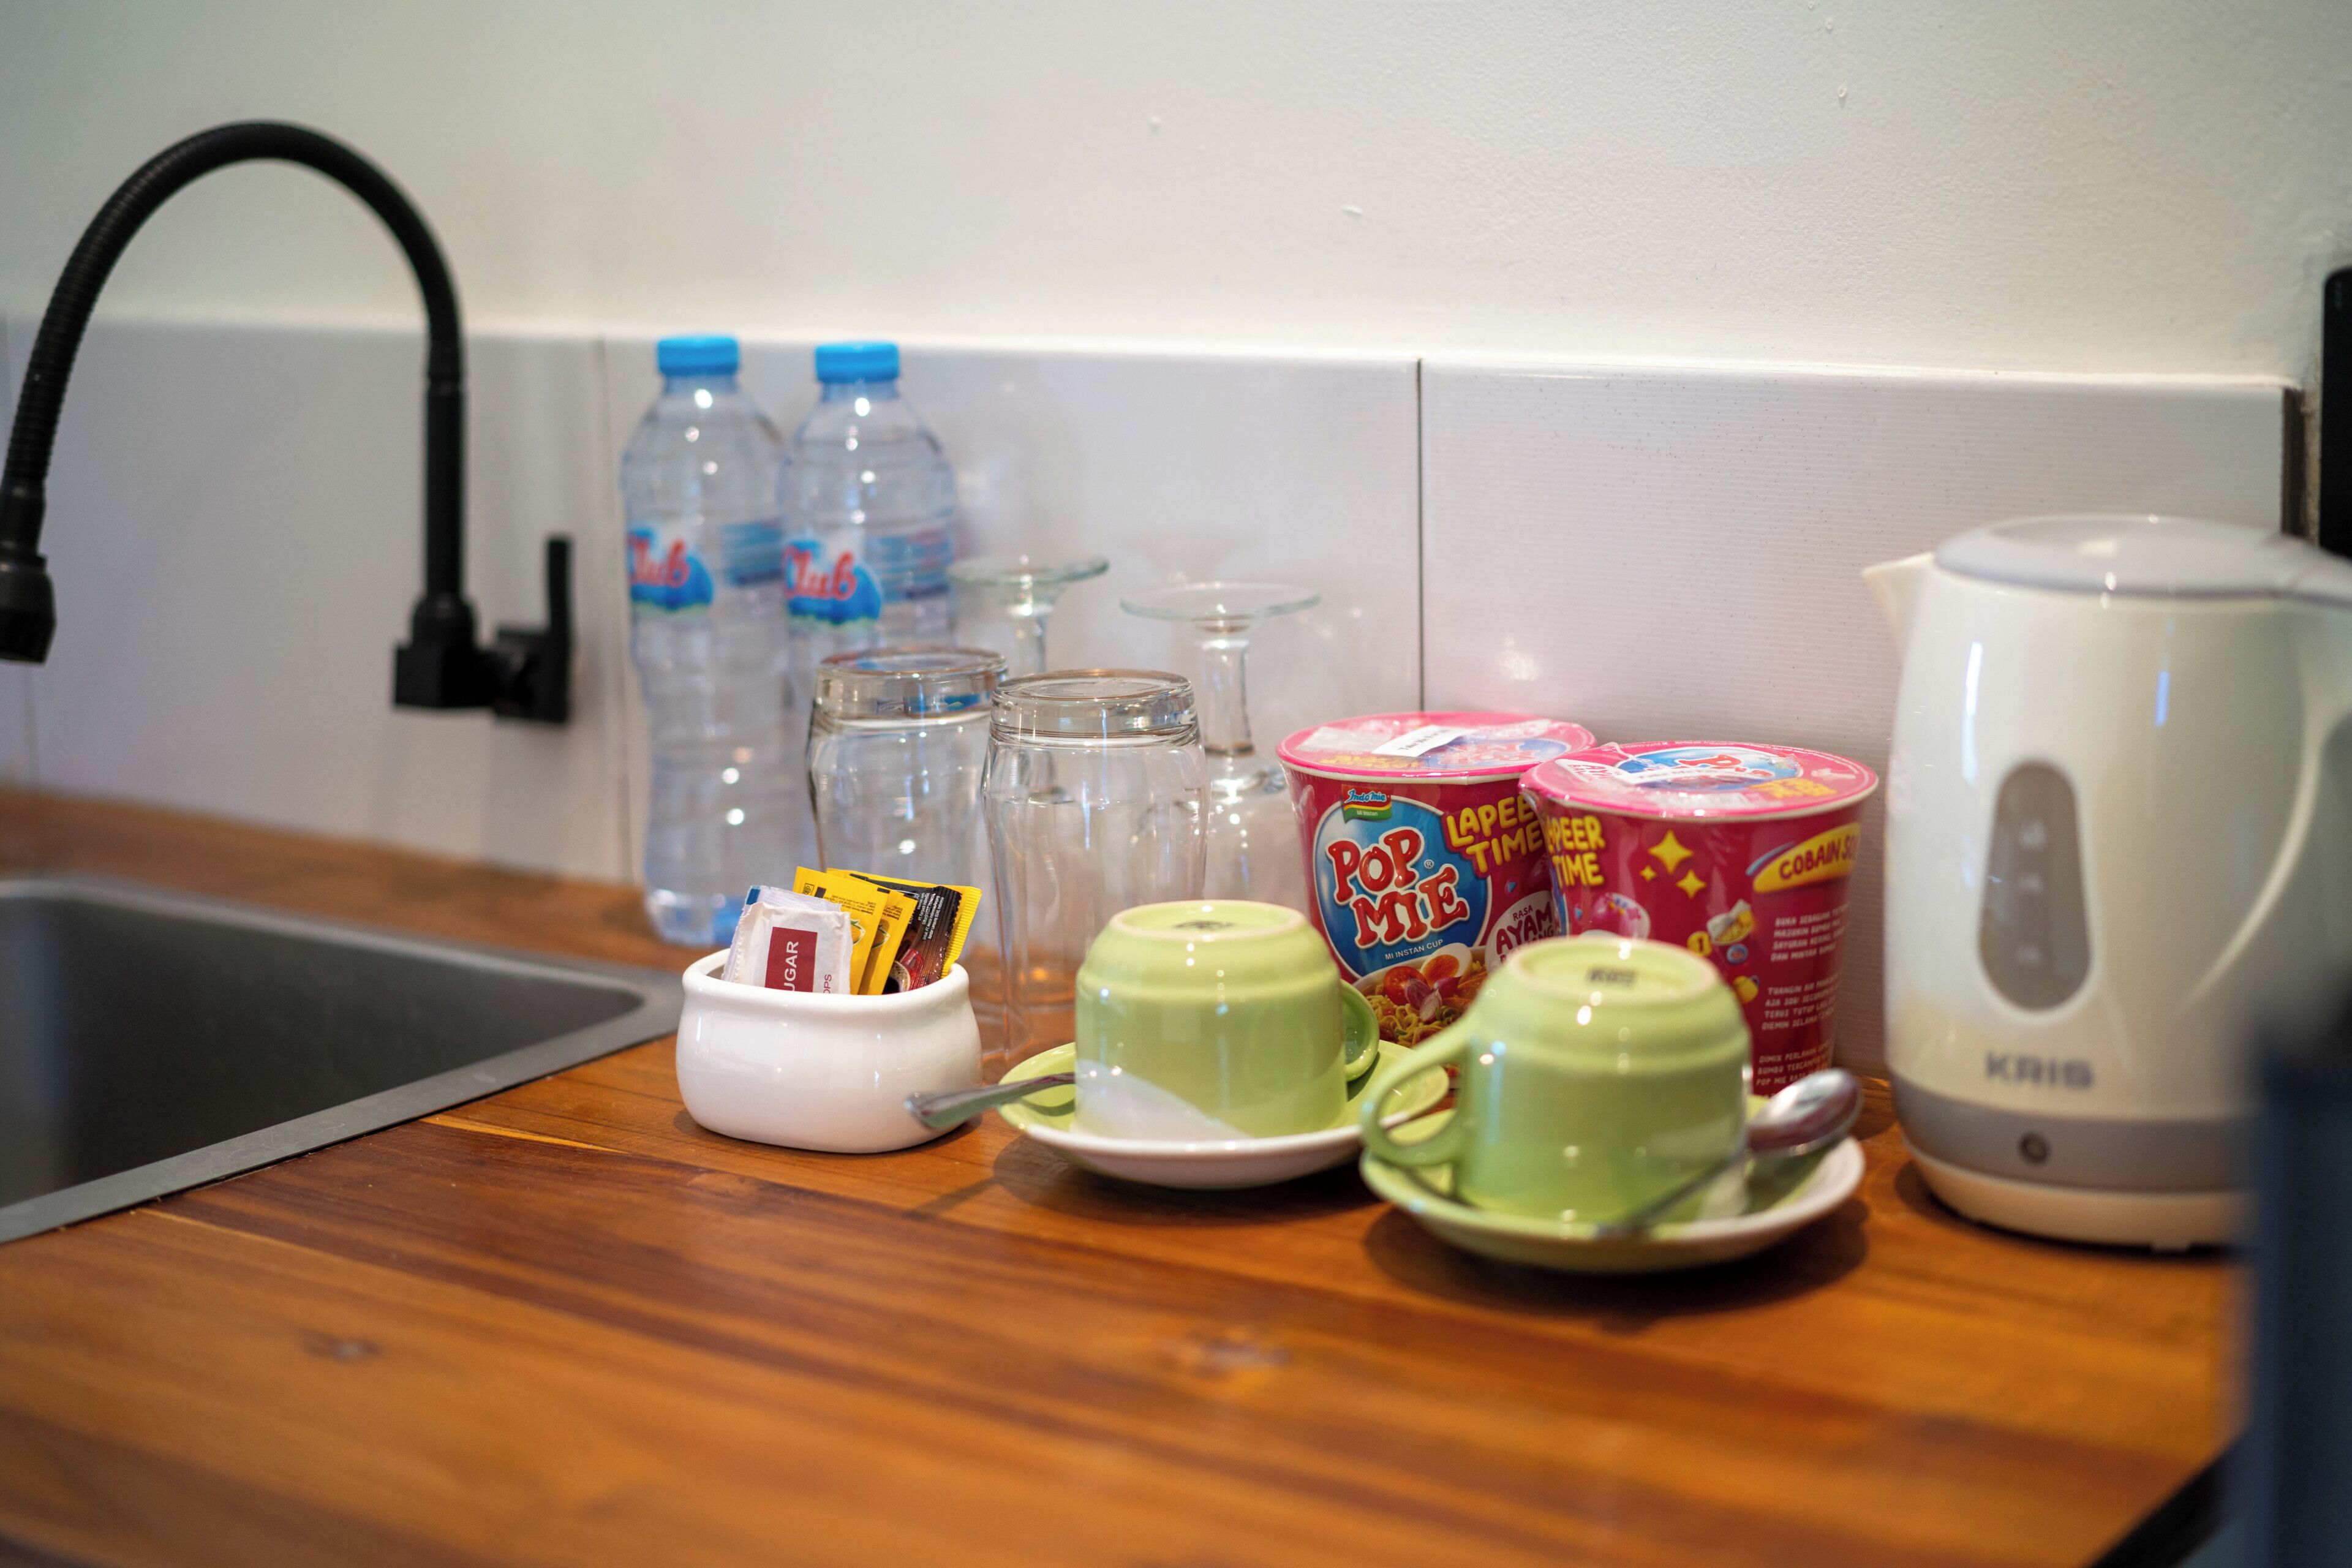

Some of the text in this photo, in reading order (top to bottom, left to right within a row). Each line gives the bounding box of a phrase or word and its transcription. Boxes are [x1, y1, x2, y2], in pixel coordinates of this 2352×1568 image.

[1447, 794, 1534, 847] LAPEE
[1327, 829, 1422, 903] POP
[1466, 820, 1544, 873] TIME
[1552, 852, 1605, 888] TIME
[1779, 837, 1841, 880] COBAIN
[1352, 866, 1469, 946] MIE
[1496, 901, 1552, 955] AYAM
[1513, 905, 1532, 921] RASA
[784, 941, 799, 991] UGAR
[1395, 946, 1425, 958] INSTAN
[1427, 940, 1444, 949] CUP
[1985, 1051, 2095, 1088] KRIS
